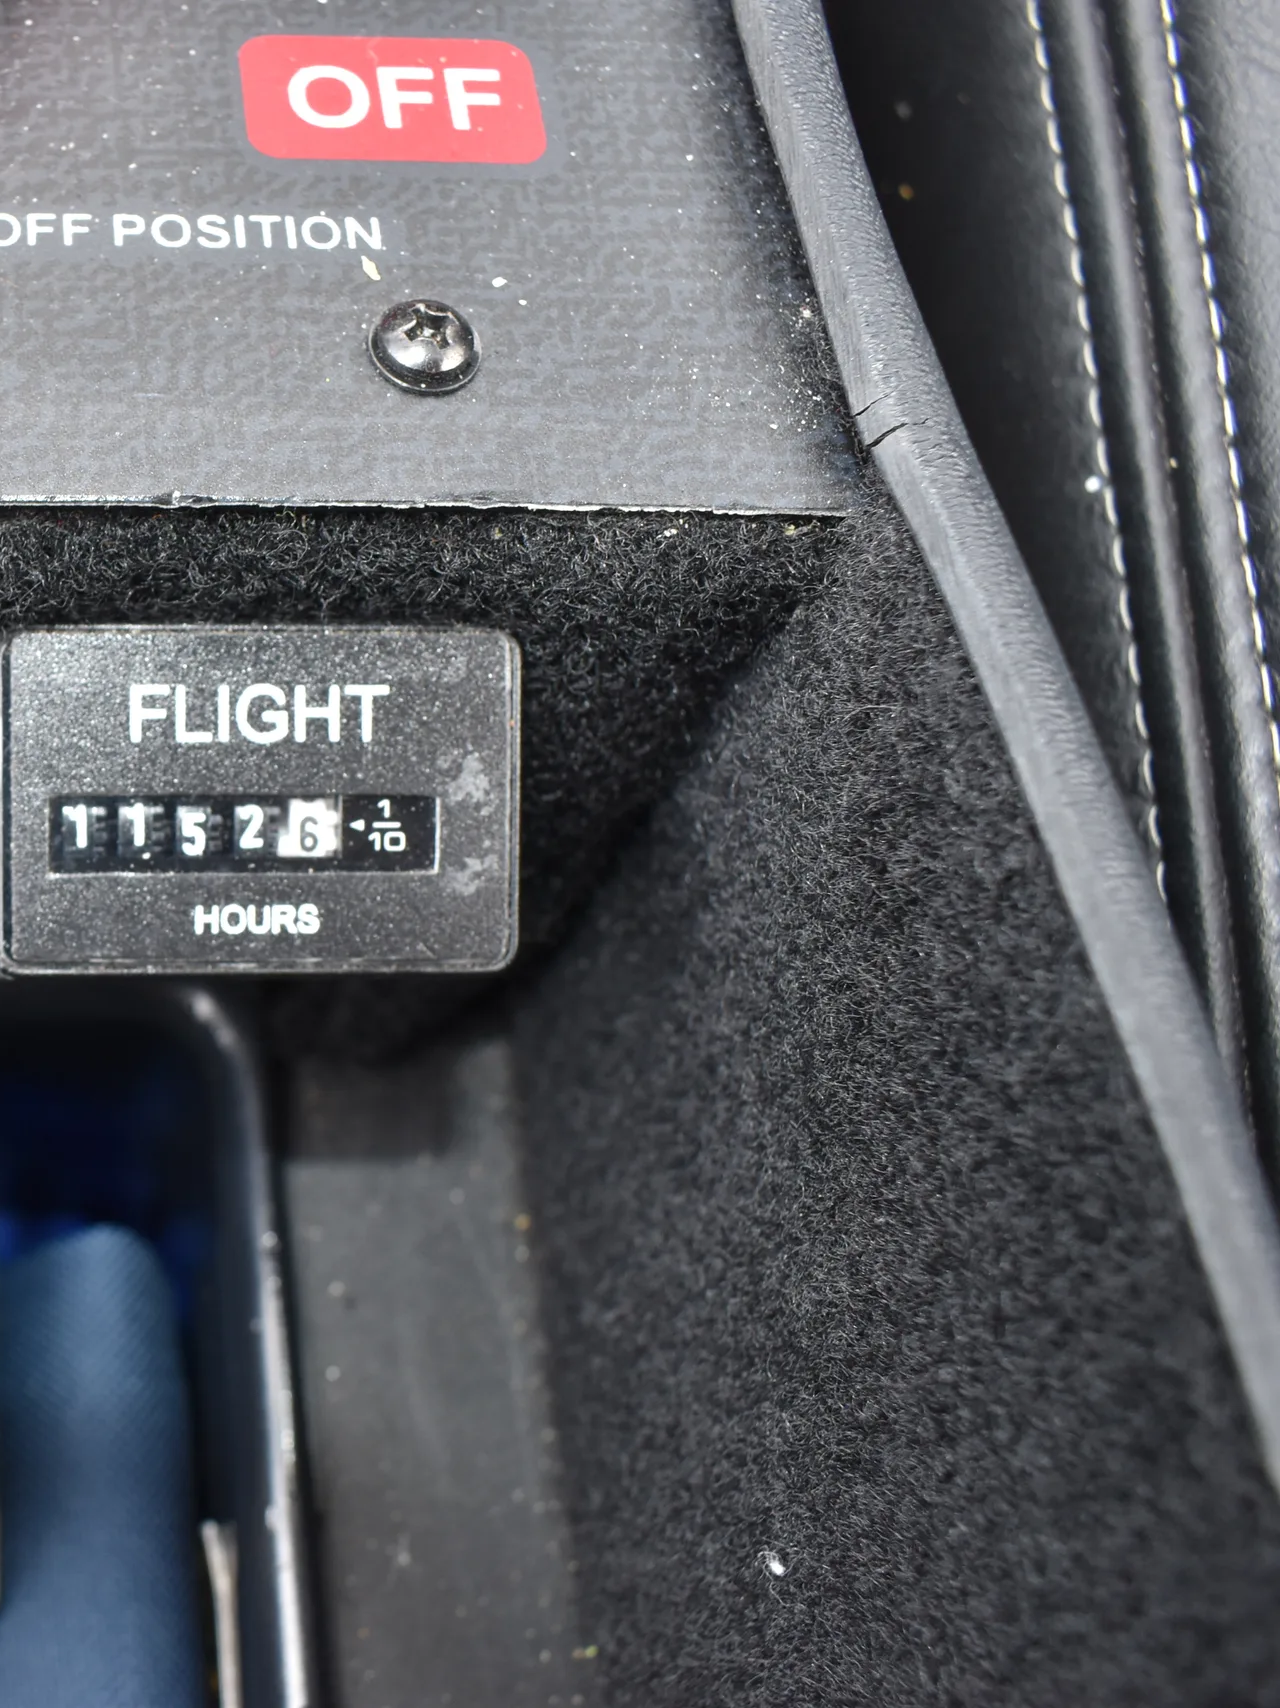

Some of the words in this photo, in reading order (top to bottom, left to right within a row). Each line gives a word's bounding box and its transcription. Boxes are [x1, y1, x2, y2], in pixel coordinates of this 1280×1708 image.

[287, 65, 501, 131] OFF
[113, 213, 383, 250] POSITION
[128, 682, 390, 745] FLIGHT
[193, 903, 321, 935] HOURS
